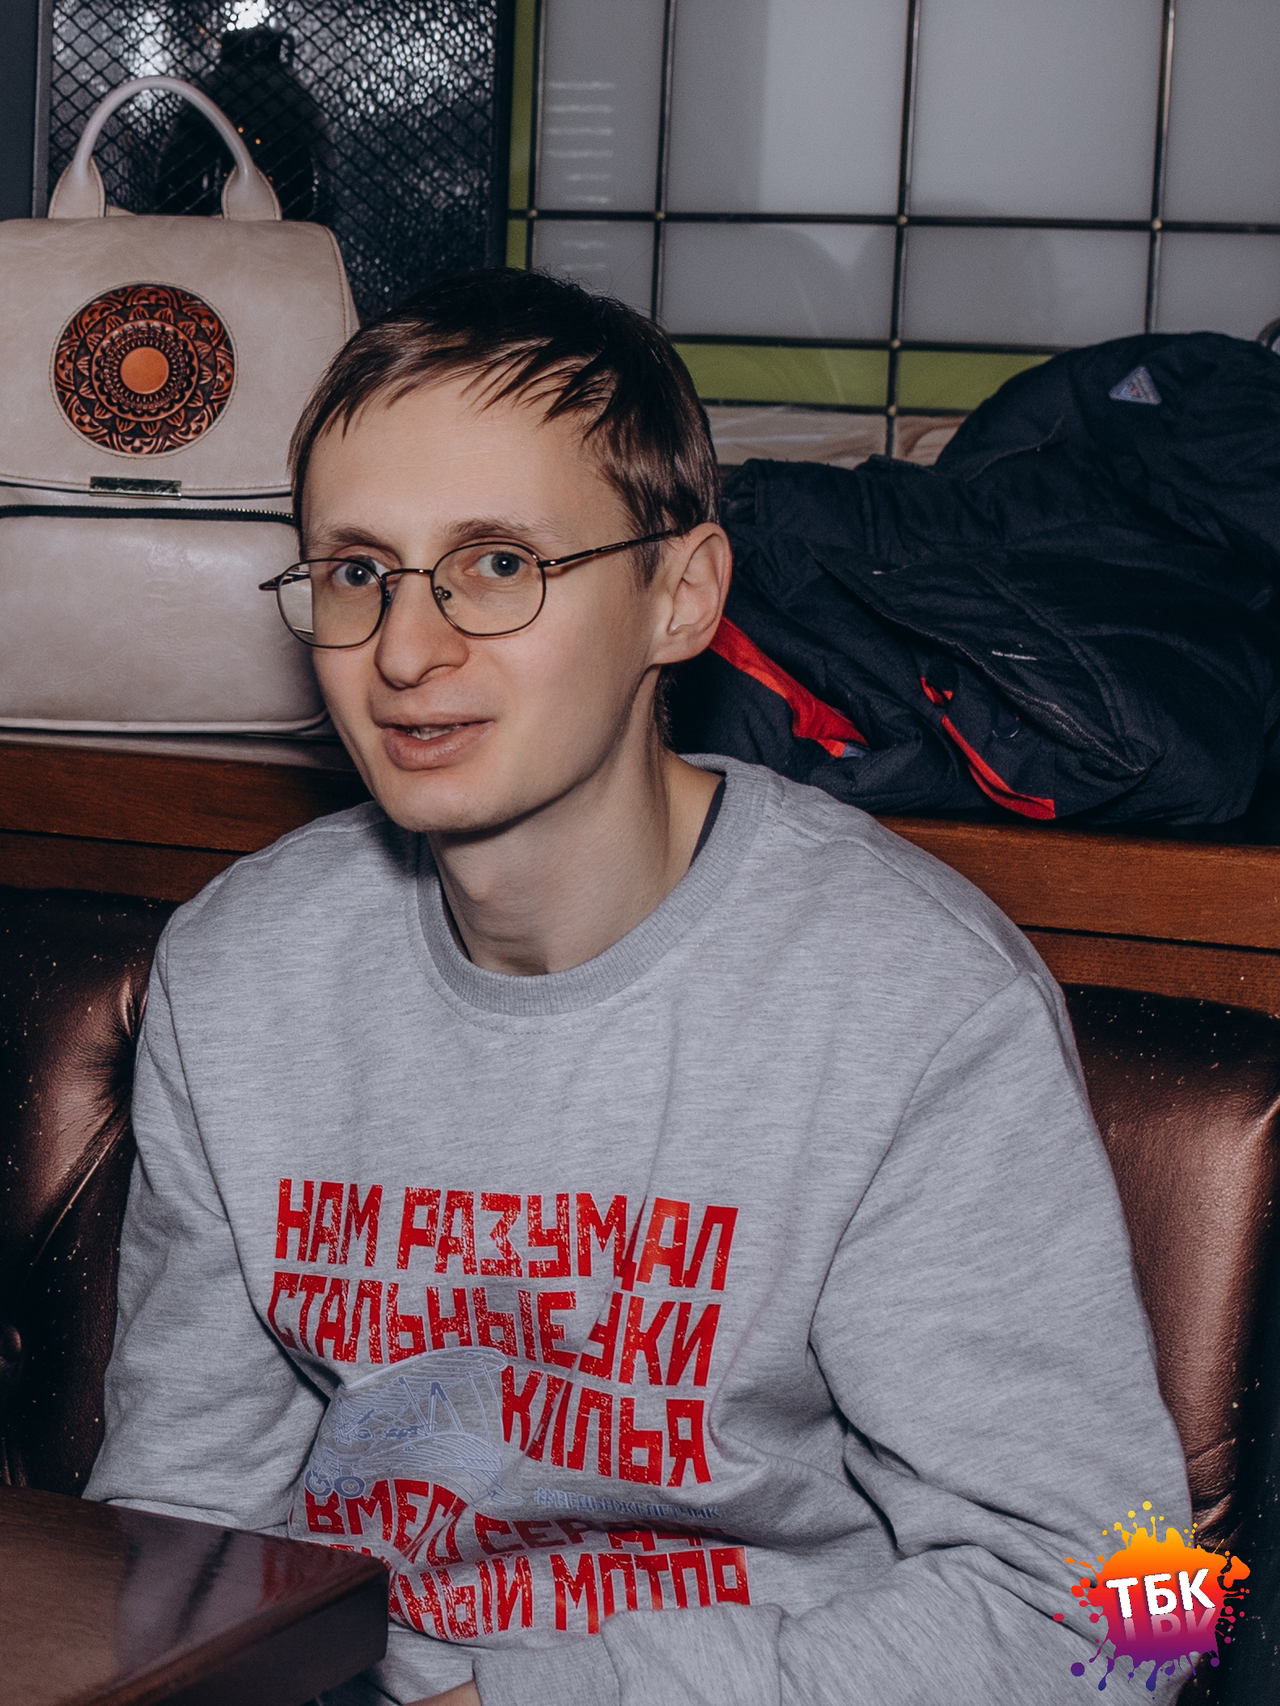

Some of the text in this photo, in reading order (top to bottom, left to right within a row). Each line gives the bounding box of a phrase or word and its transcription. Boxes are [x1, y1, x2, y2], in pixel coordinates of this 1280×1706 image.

[274, 1178, 383, 1267] НАМ
[396, 1186, 628, 1278] РАЗУМ
[267, 1271, 578, 1370] СТАЛЬНЫЕ
